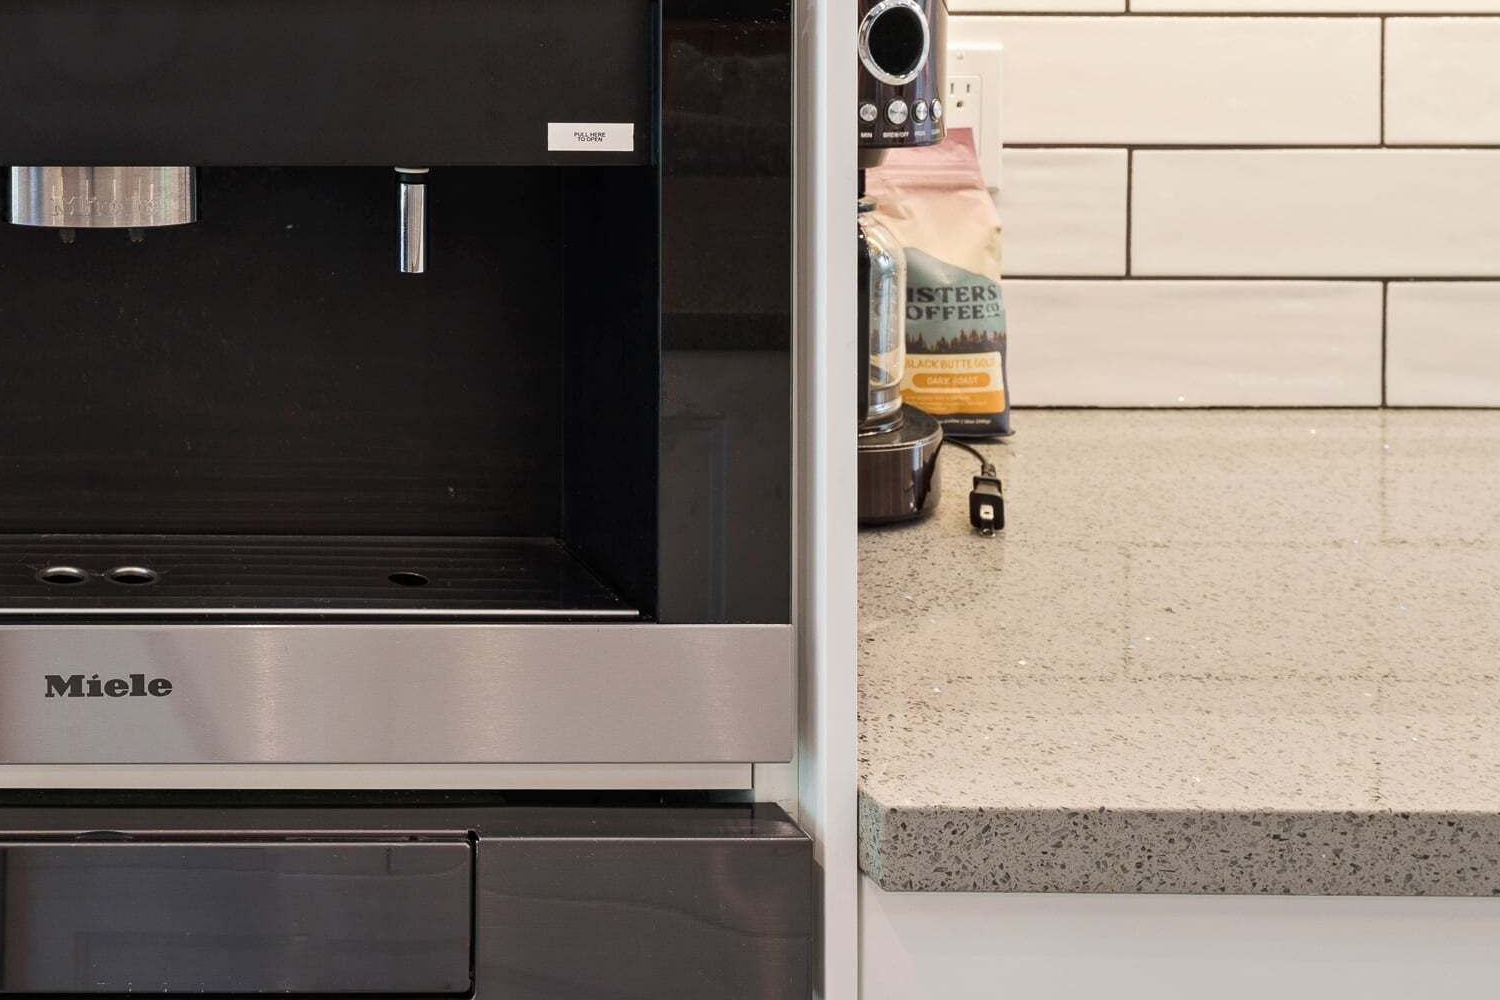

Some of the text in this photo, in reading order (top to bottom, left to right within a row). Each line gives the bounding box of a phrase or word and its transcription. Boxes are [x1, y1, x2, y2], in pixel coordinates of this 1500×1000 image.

[906, 285, 997, 303] ISTERS
[906, 305, 985, 321] OFFEE
[44, 673, 173, 697] Miele
